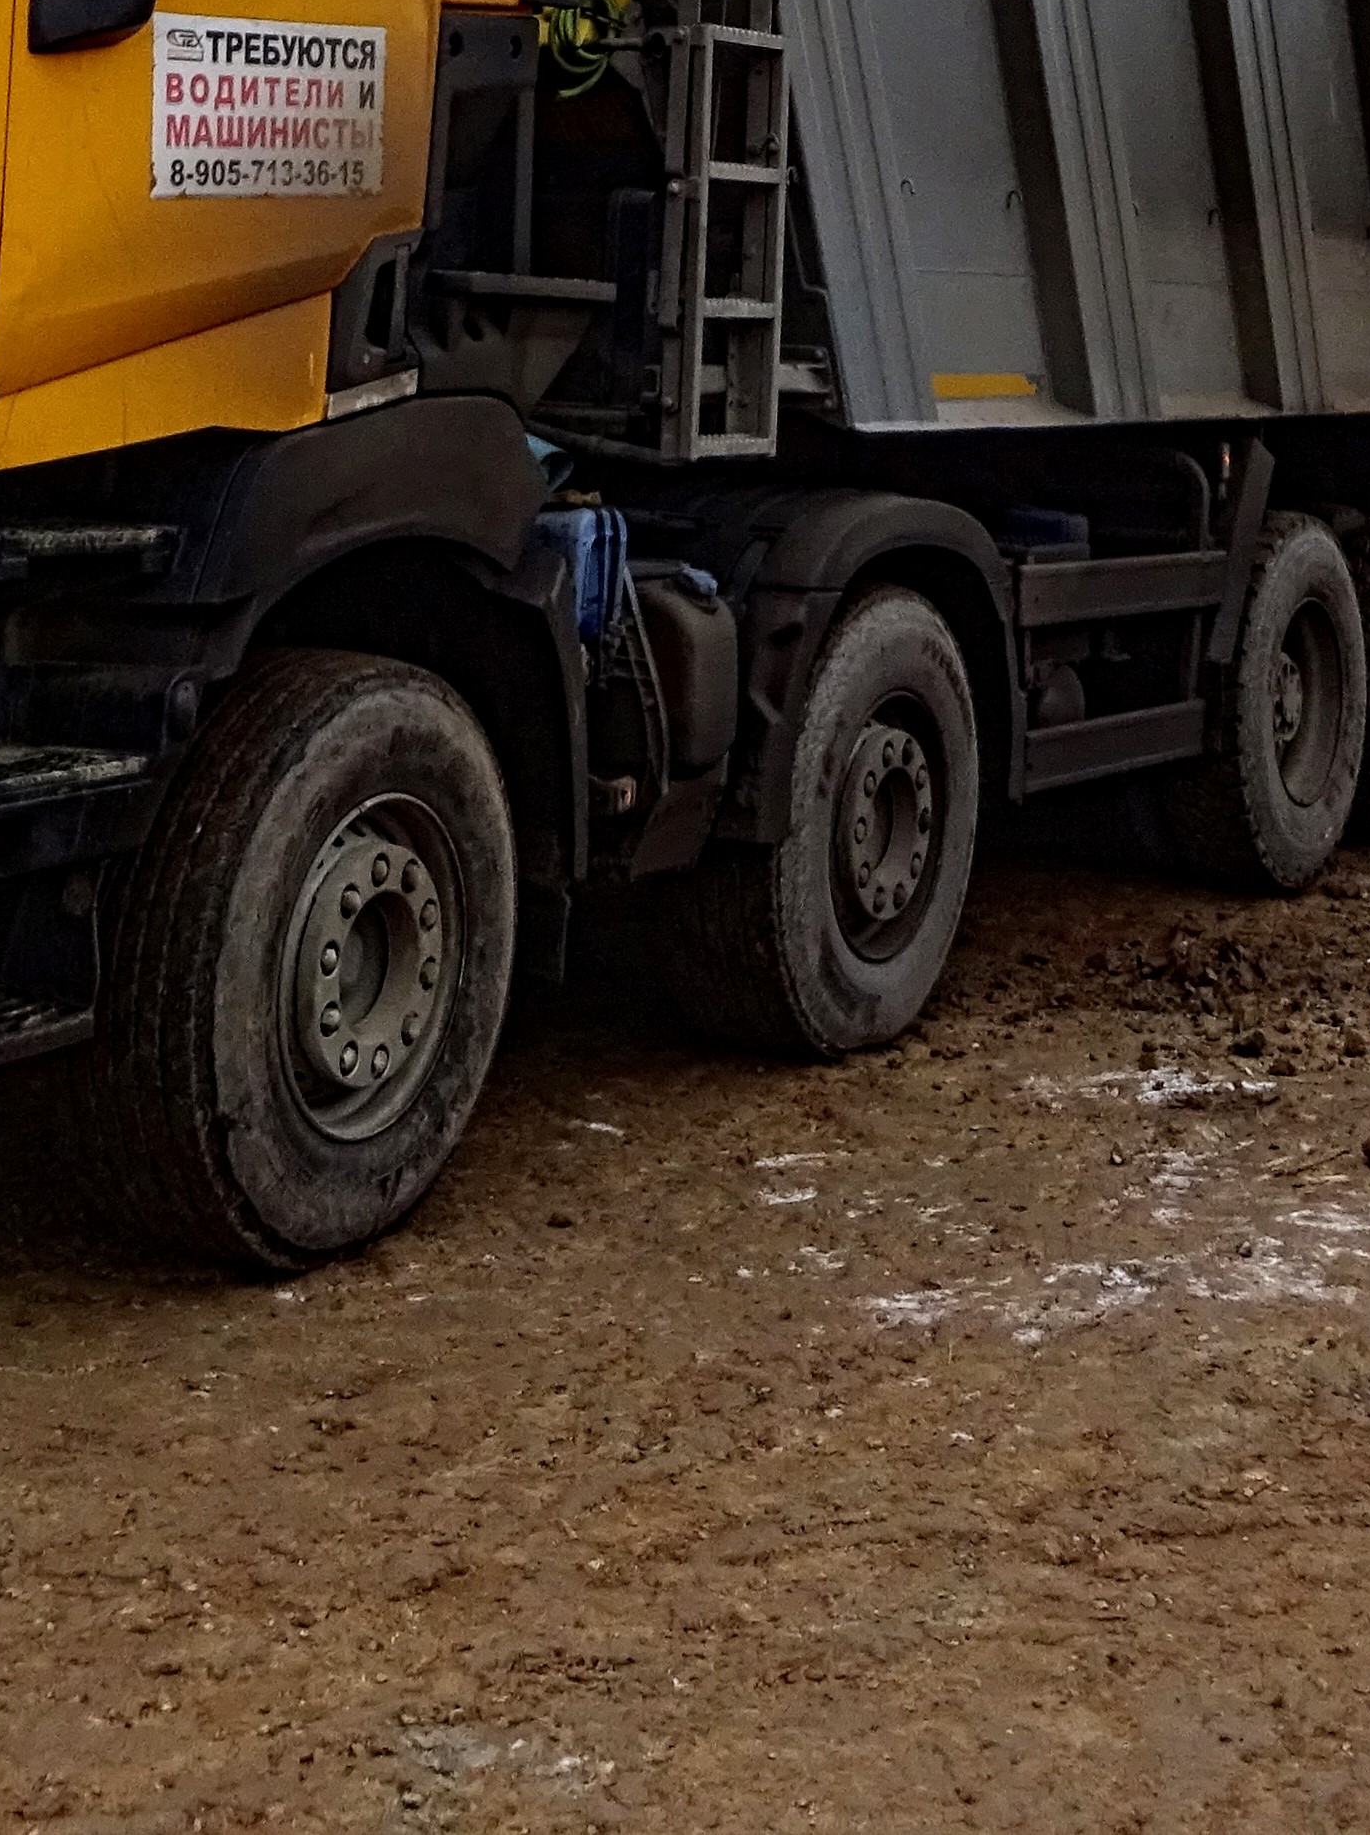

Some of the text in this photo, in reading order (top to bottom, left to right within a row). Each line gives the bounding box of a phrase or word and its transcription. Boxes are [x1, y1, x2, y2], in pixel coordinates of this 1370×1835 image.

[205, 29, 376, 70] ТРЕБУЮТСЯ
[165, 72, 376, 111] ВОДИТЕЛИ И
[165, 114, 374, 150] МАШИНИСТЫ
[170, 159, 365, 186] 8-905-713-36-15
